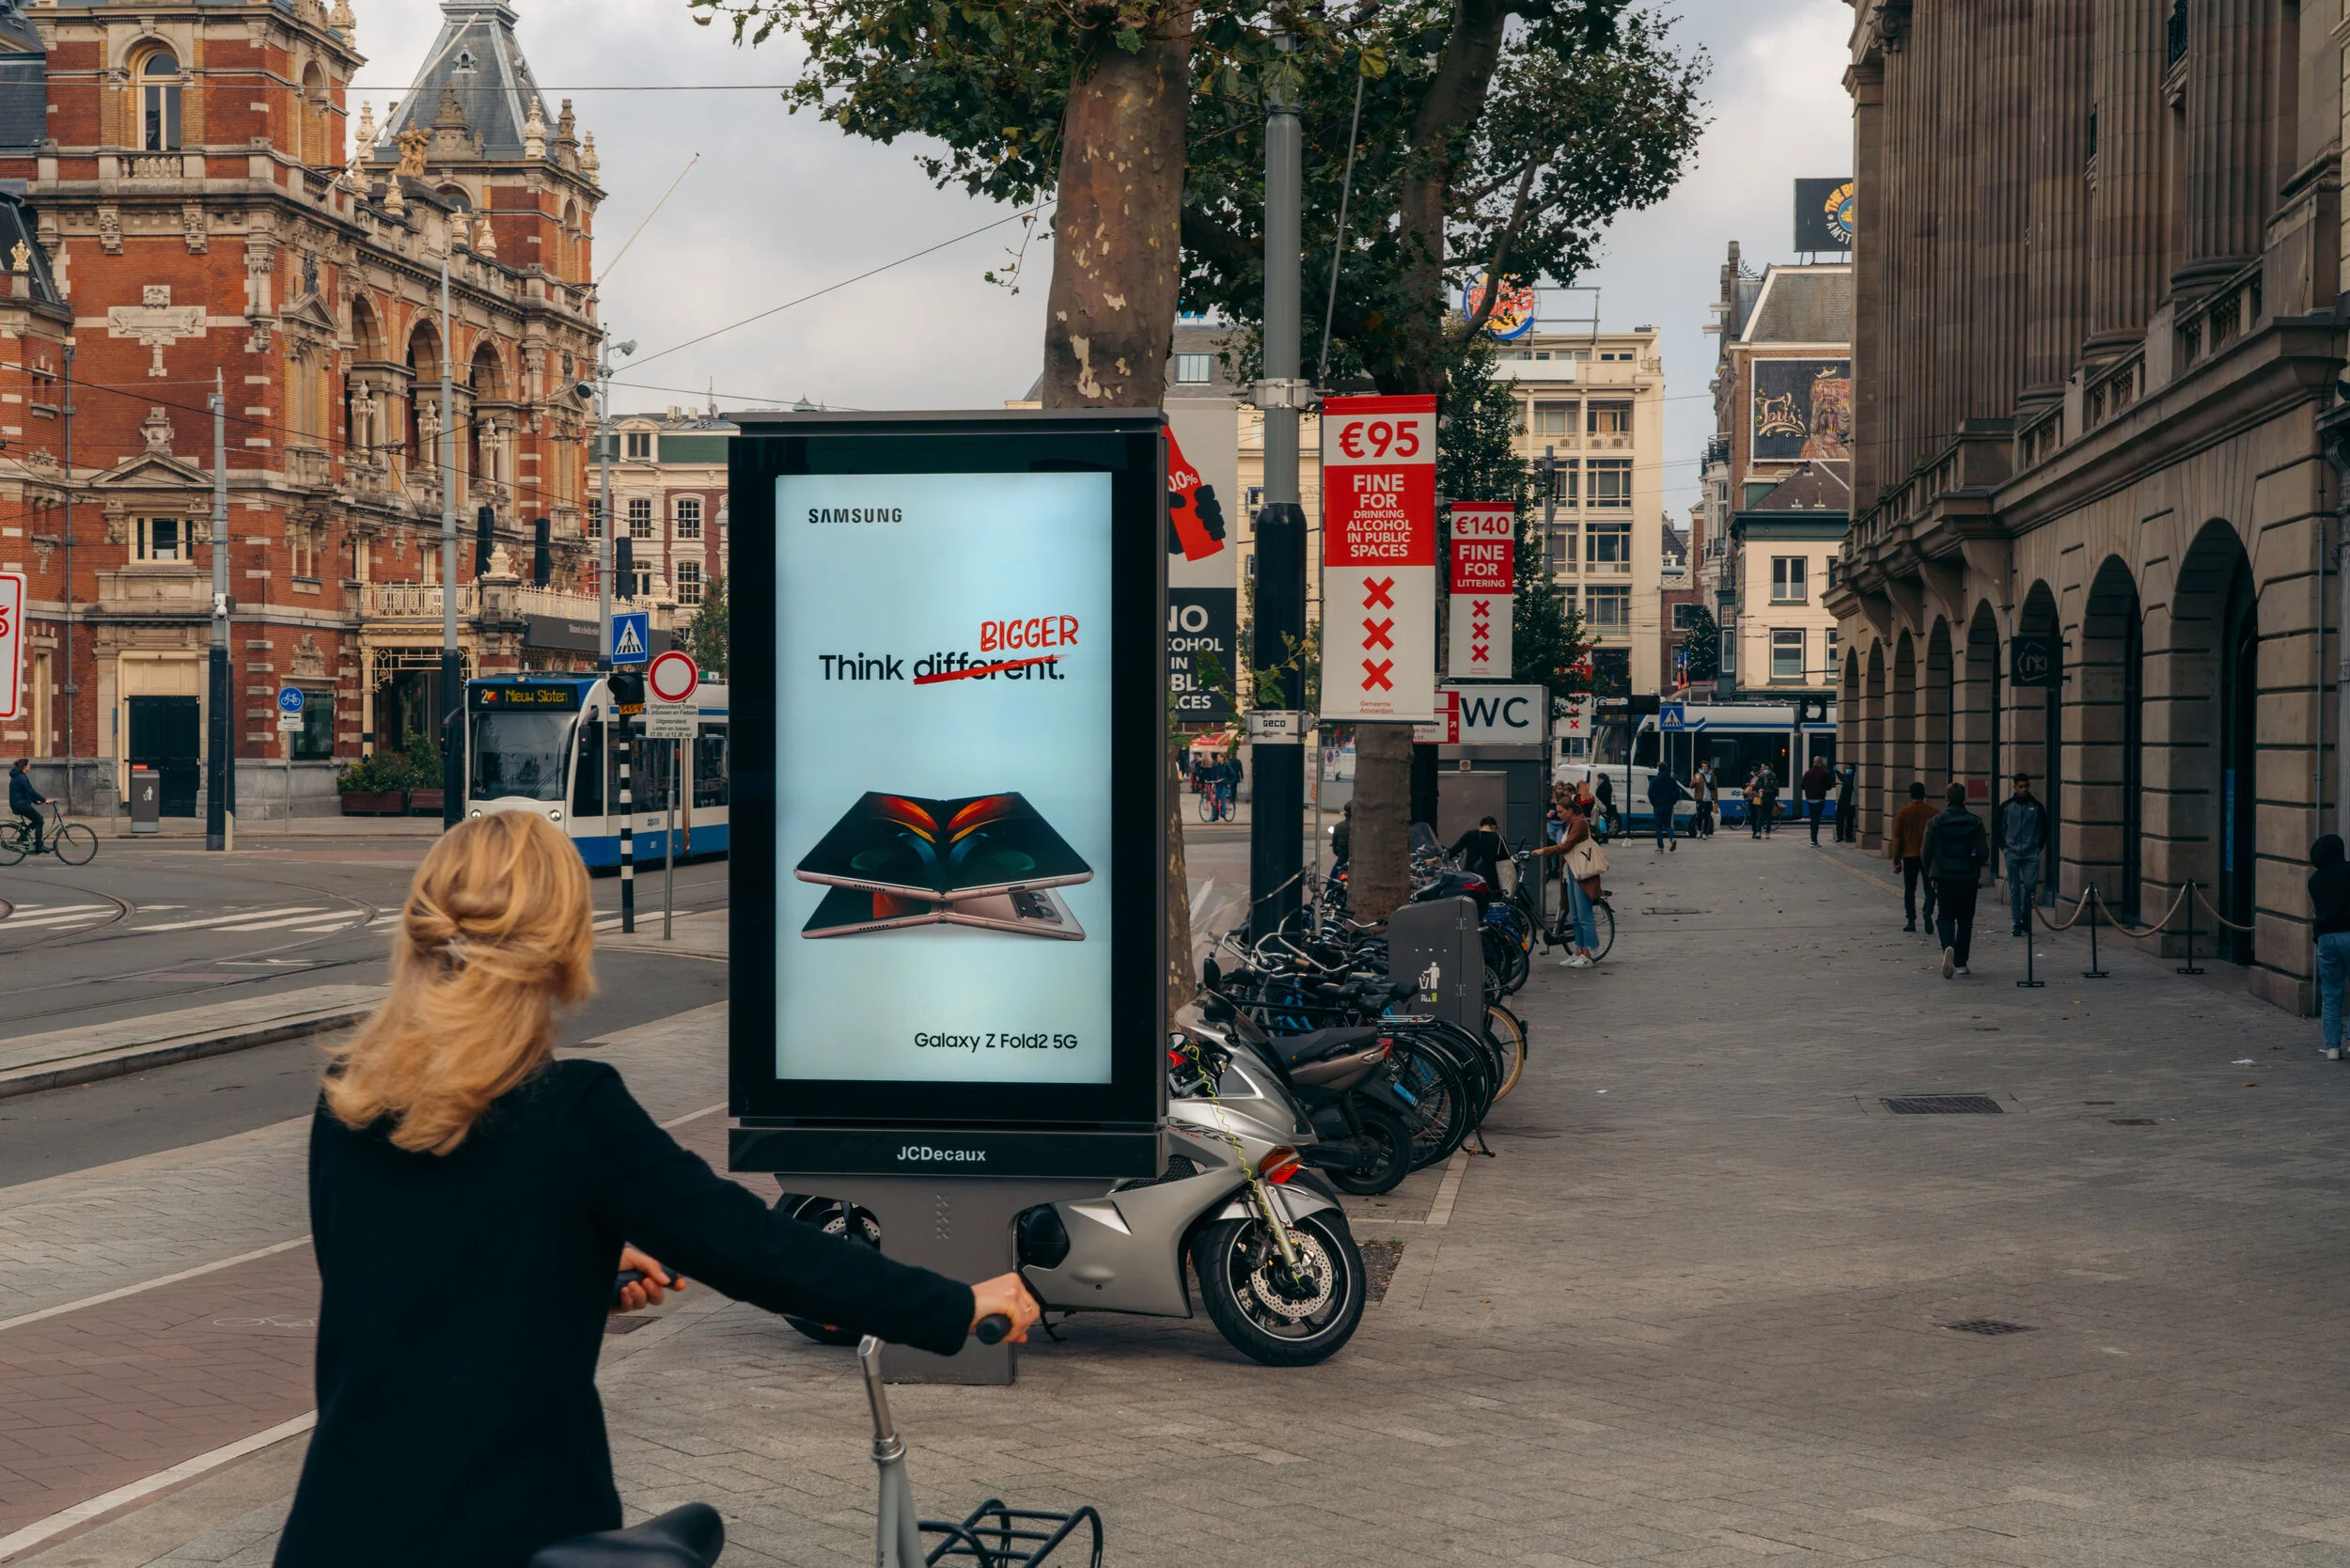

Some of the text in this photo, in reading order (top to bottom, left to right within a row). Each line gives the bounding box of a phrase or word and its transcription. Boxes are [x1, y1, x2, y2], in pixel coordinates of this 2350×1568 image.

[1825, 222, 1852, 245] AMST
[1339, 421, 1420, 459] €95
[1353, 474, 1404, 493] FINE
[1360, 494, 1398, 509] FOR
[808, 509, 903, 524] SAMSUNG
[1354, 510, 1405, 519] DRINKING
[1346, 520, 1412, 532] ALCOHOL
[1455, 516, 1510, 536] €140
[1347, 531, 1411, 543] IN PUBLIC
[1350, 544, 1408, 557] SPACES
[1459, 544, 1505, 560] FINE
[1465, 562, 1498, 576] FOR
[1457, 579, 1506, 588] LITTERING
[980, 615, 1078, 652] BIGGER
[819, 651, 1065, 682] Think different.
[1170, 656, 1188, 669] IN
[481, 689, 568, 704] 2 Nieuw Sloten
[1175, 696, 1212, 710] CES
[1461, 697, 1529, 728] WC
[915, 1032, 1077, 1053] Galaxy Z Fold2 5G
[897, 1146, 987, 1162] JCDecaux
